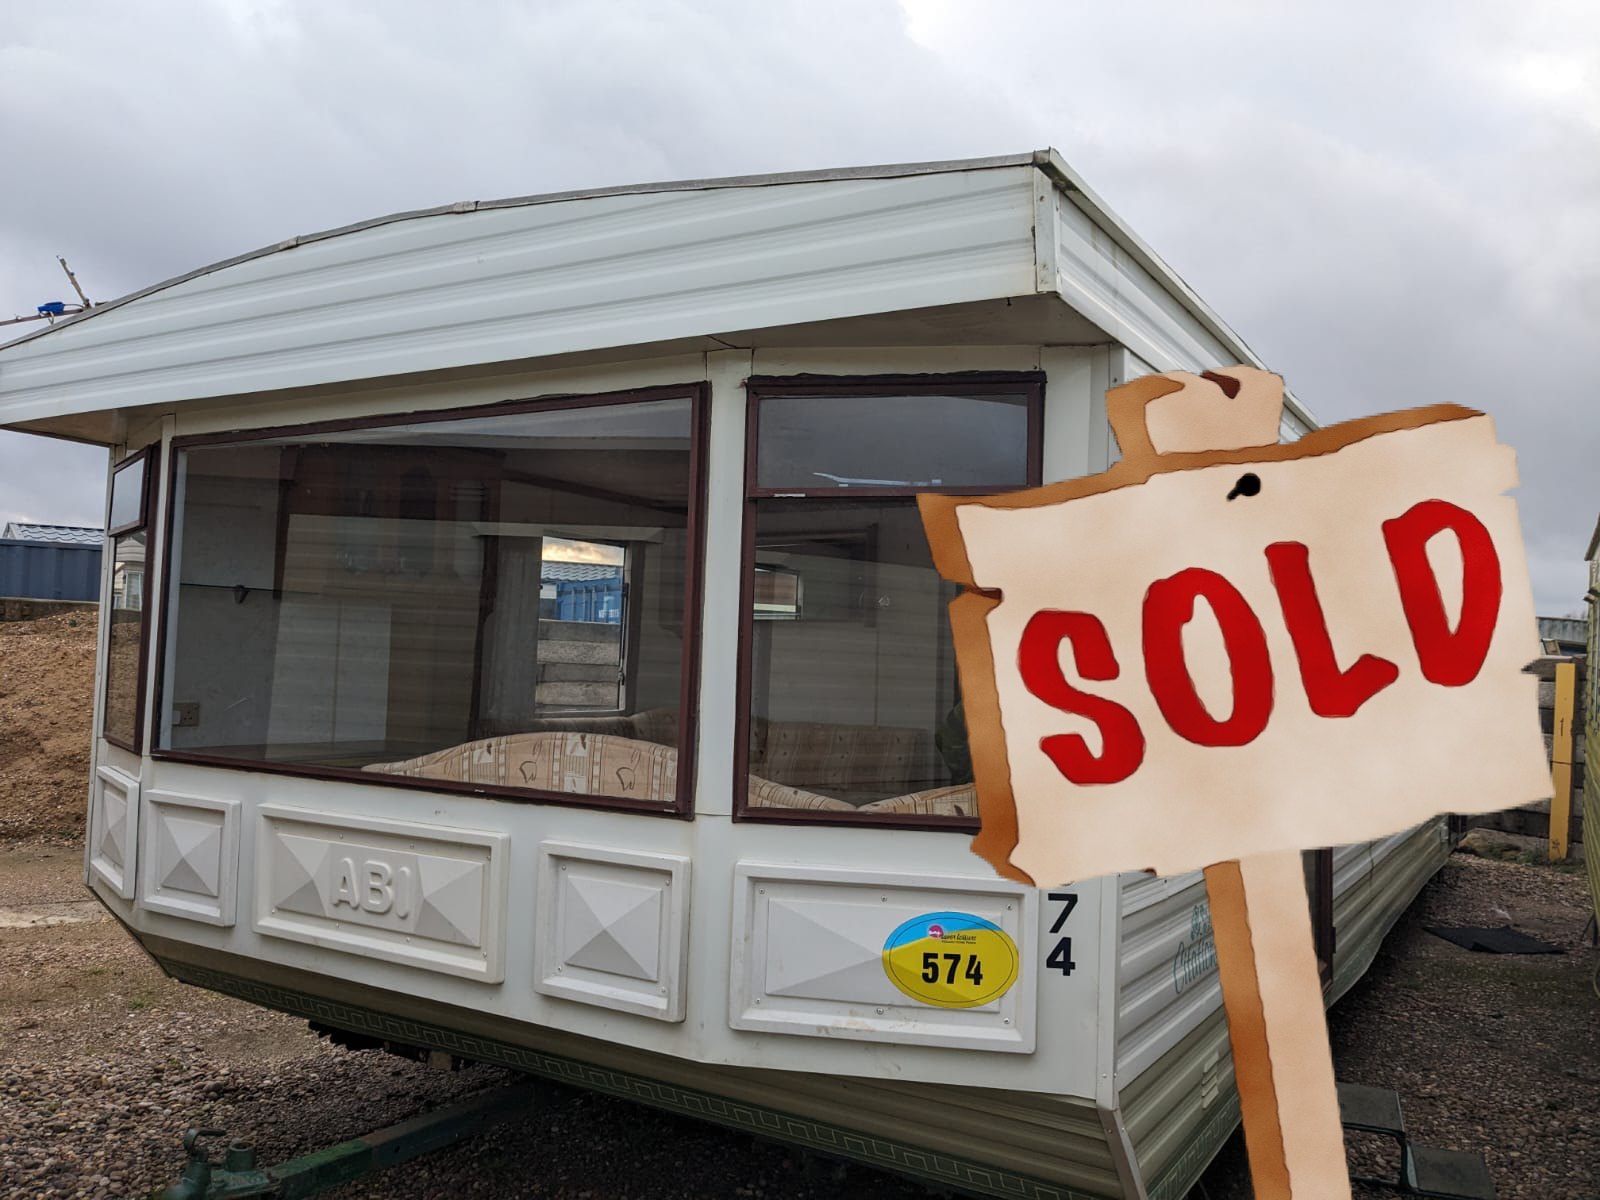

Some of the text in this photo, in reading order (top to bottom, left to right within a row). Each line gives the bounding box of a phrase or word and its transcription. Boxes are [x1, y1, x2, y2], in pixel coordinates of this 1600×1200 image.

[331, 857, 411, 920] ABI
[1046, 884, 1078, 976] 74
[921, 952, 983, 985] 574
